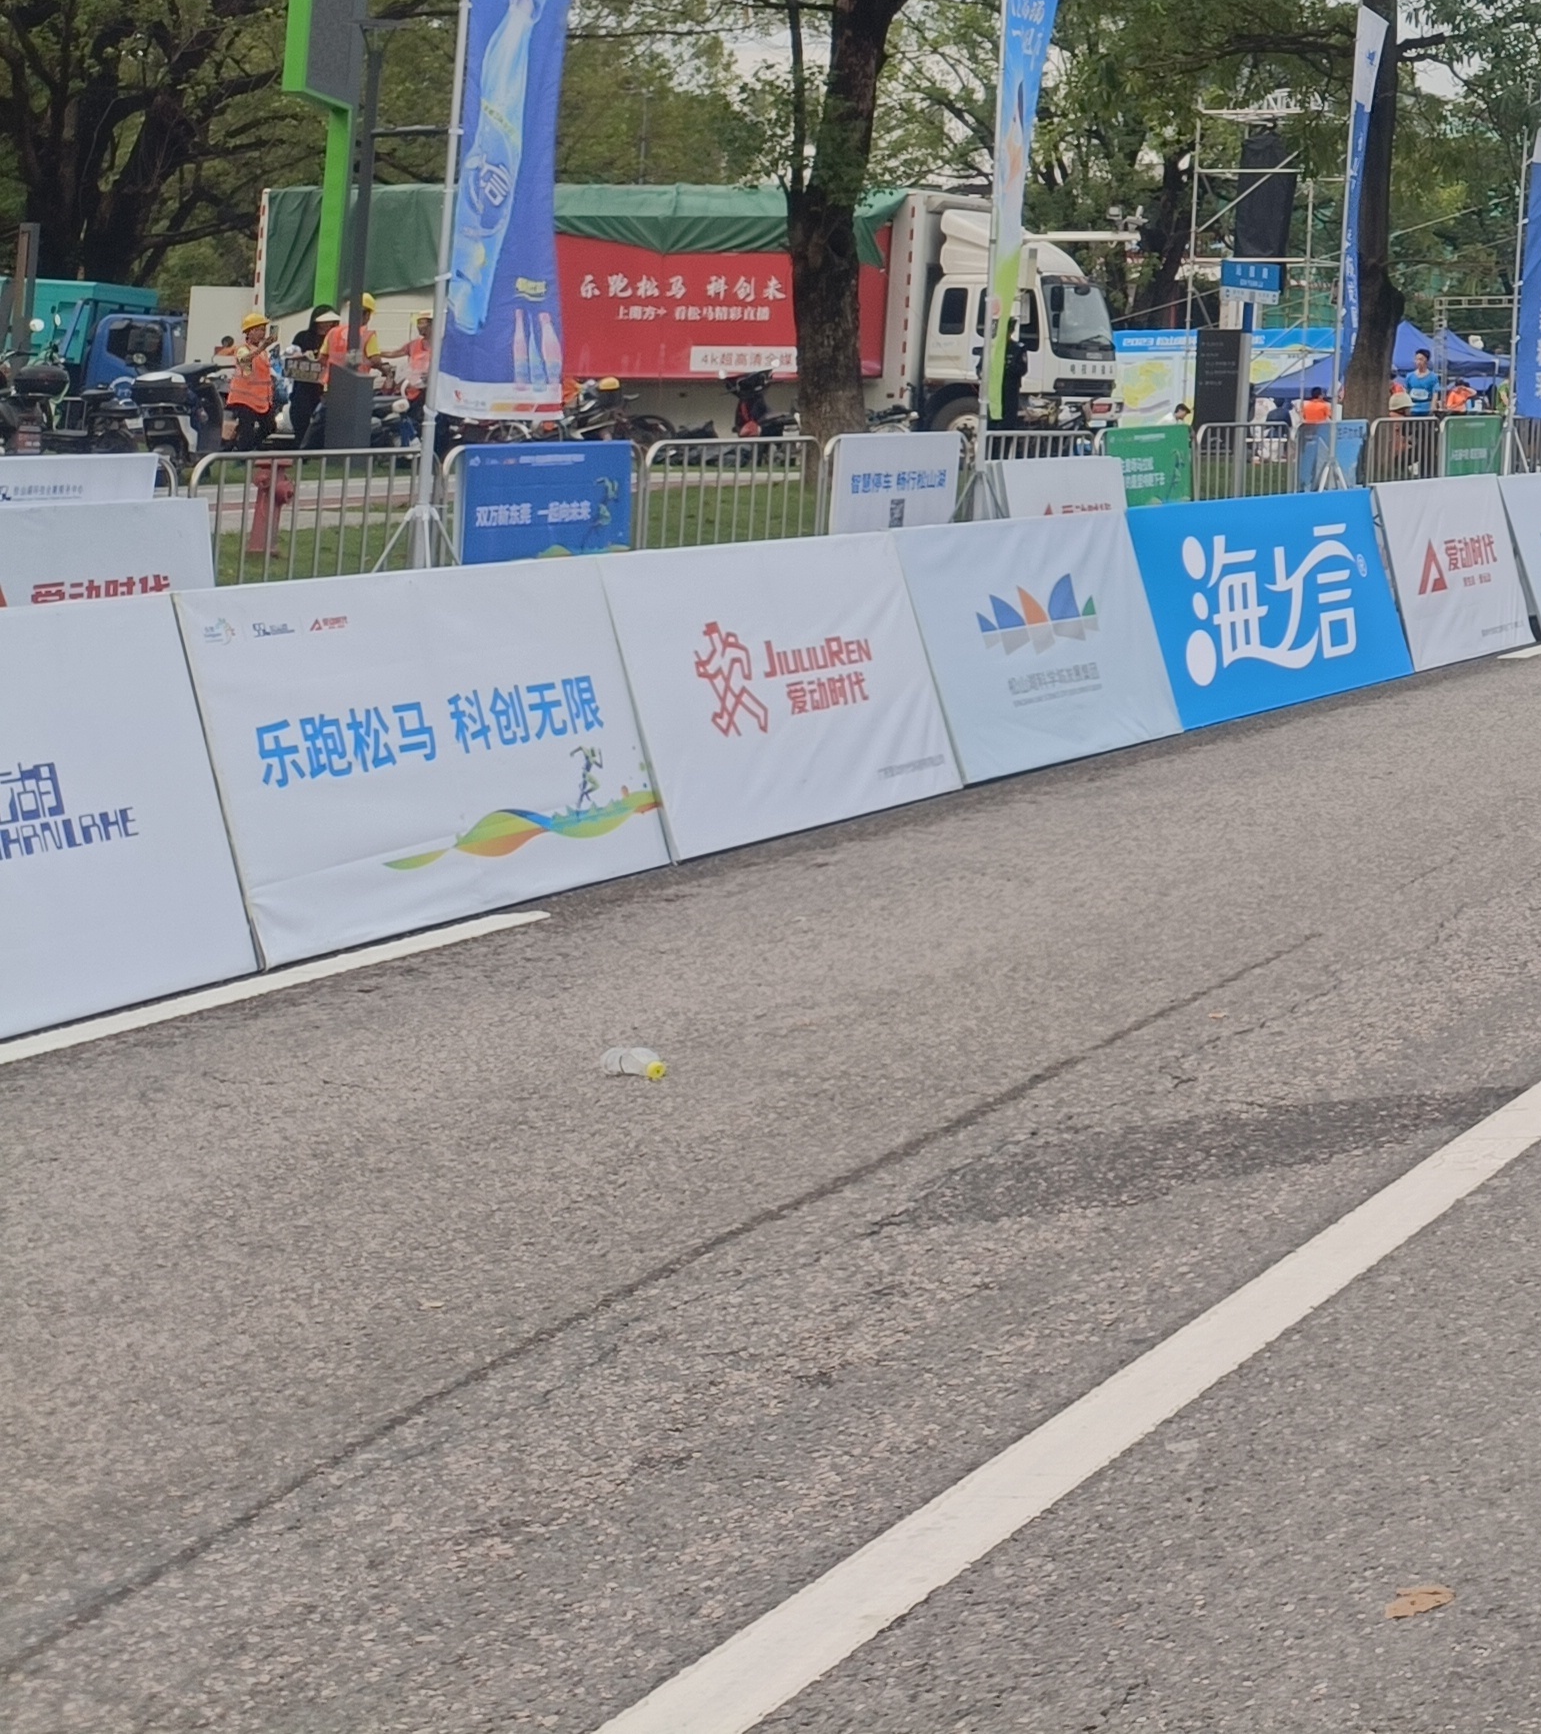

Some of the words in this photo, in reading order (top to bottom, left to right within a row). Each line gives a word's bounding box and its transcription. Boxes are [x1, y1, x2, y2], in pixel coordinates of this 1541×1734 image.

[579, 273, 687, 299] 乐跑松马
[1444, 533, 1497, 572] 爱动时代
[786, 671, 869, 715] 爱动时代
[256, 700, 438, 789] 乐跑松马
[448, 674, 604, 755] 科创无限
